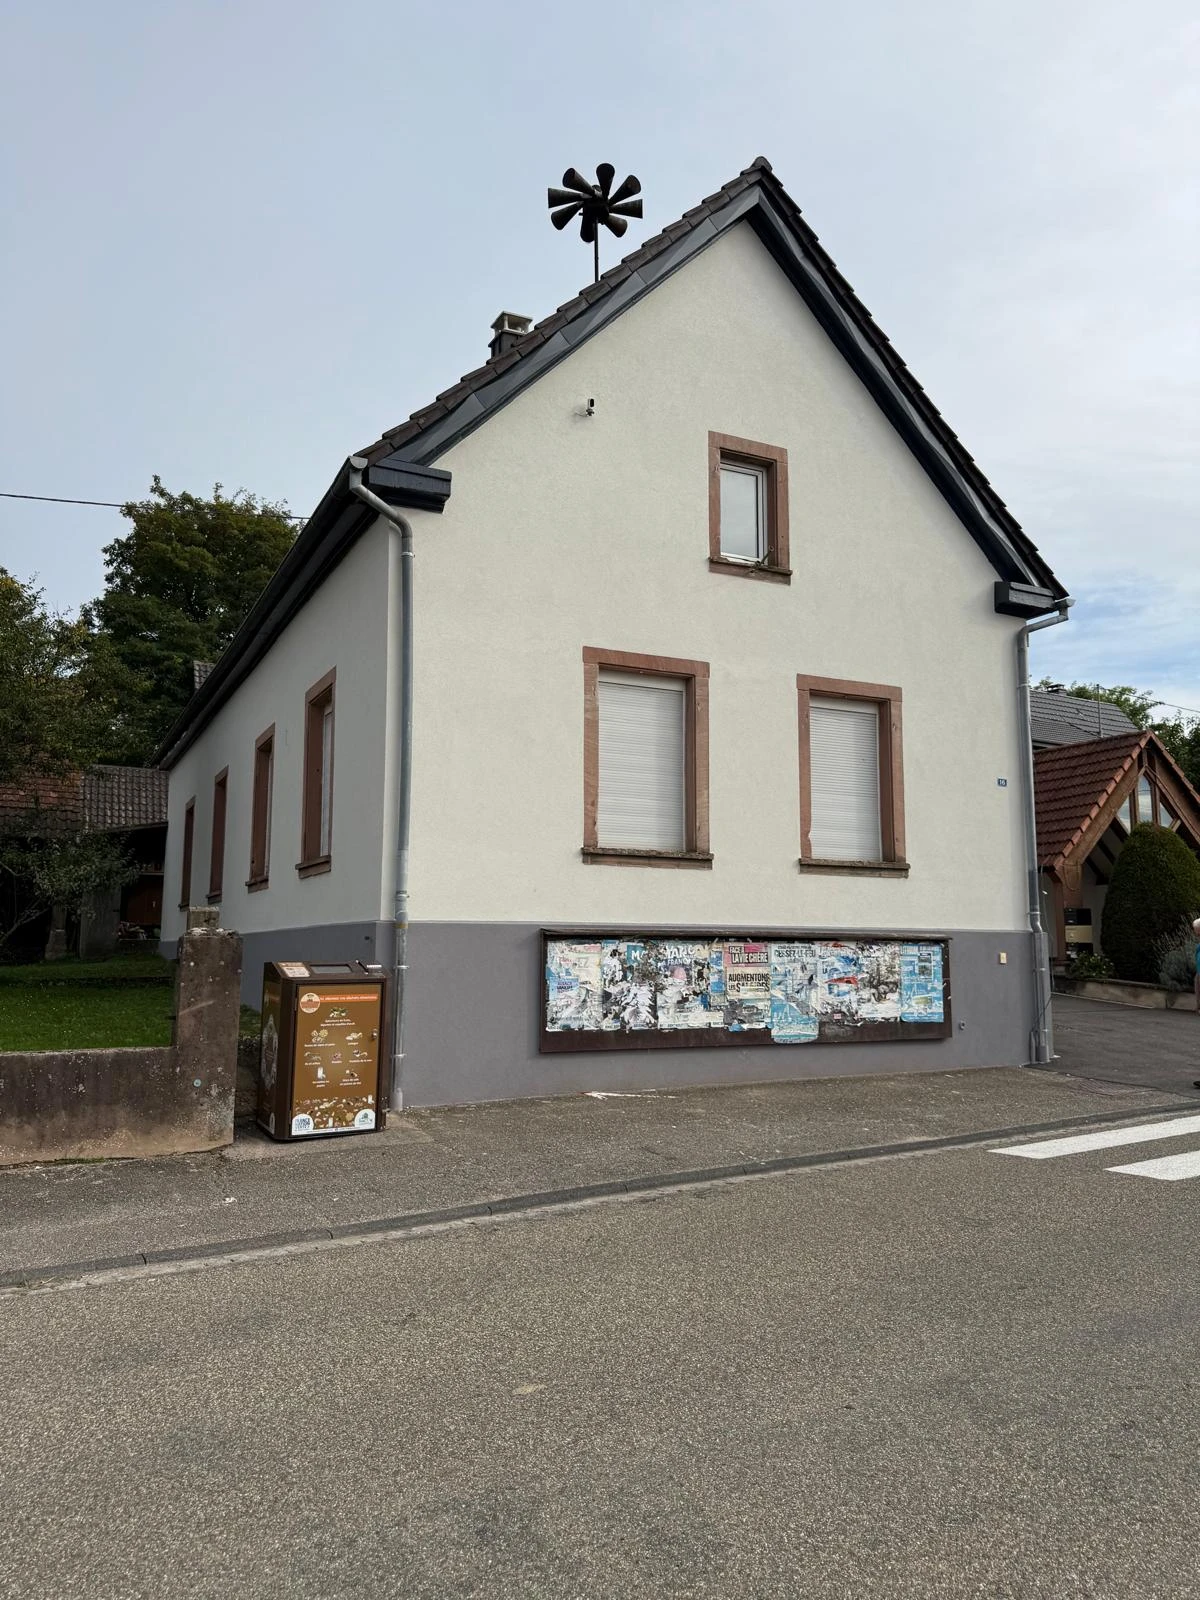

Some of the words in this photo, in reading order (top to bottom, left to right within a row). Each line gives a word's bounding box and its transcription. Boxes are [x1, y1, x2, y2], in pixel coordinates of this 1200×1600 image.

[730, 946, 741, 954] FACE
[732, 953, 740, 964] LA
[739, 952, 749, 963] VIE
[728, 973, 770, 982] AUGMENTONS
